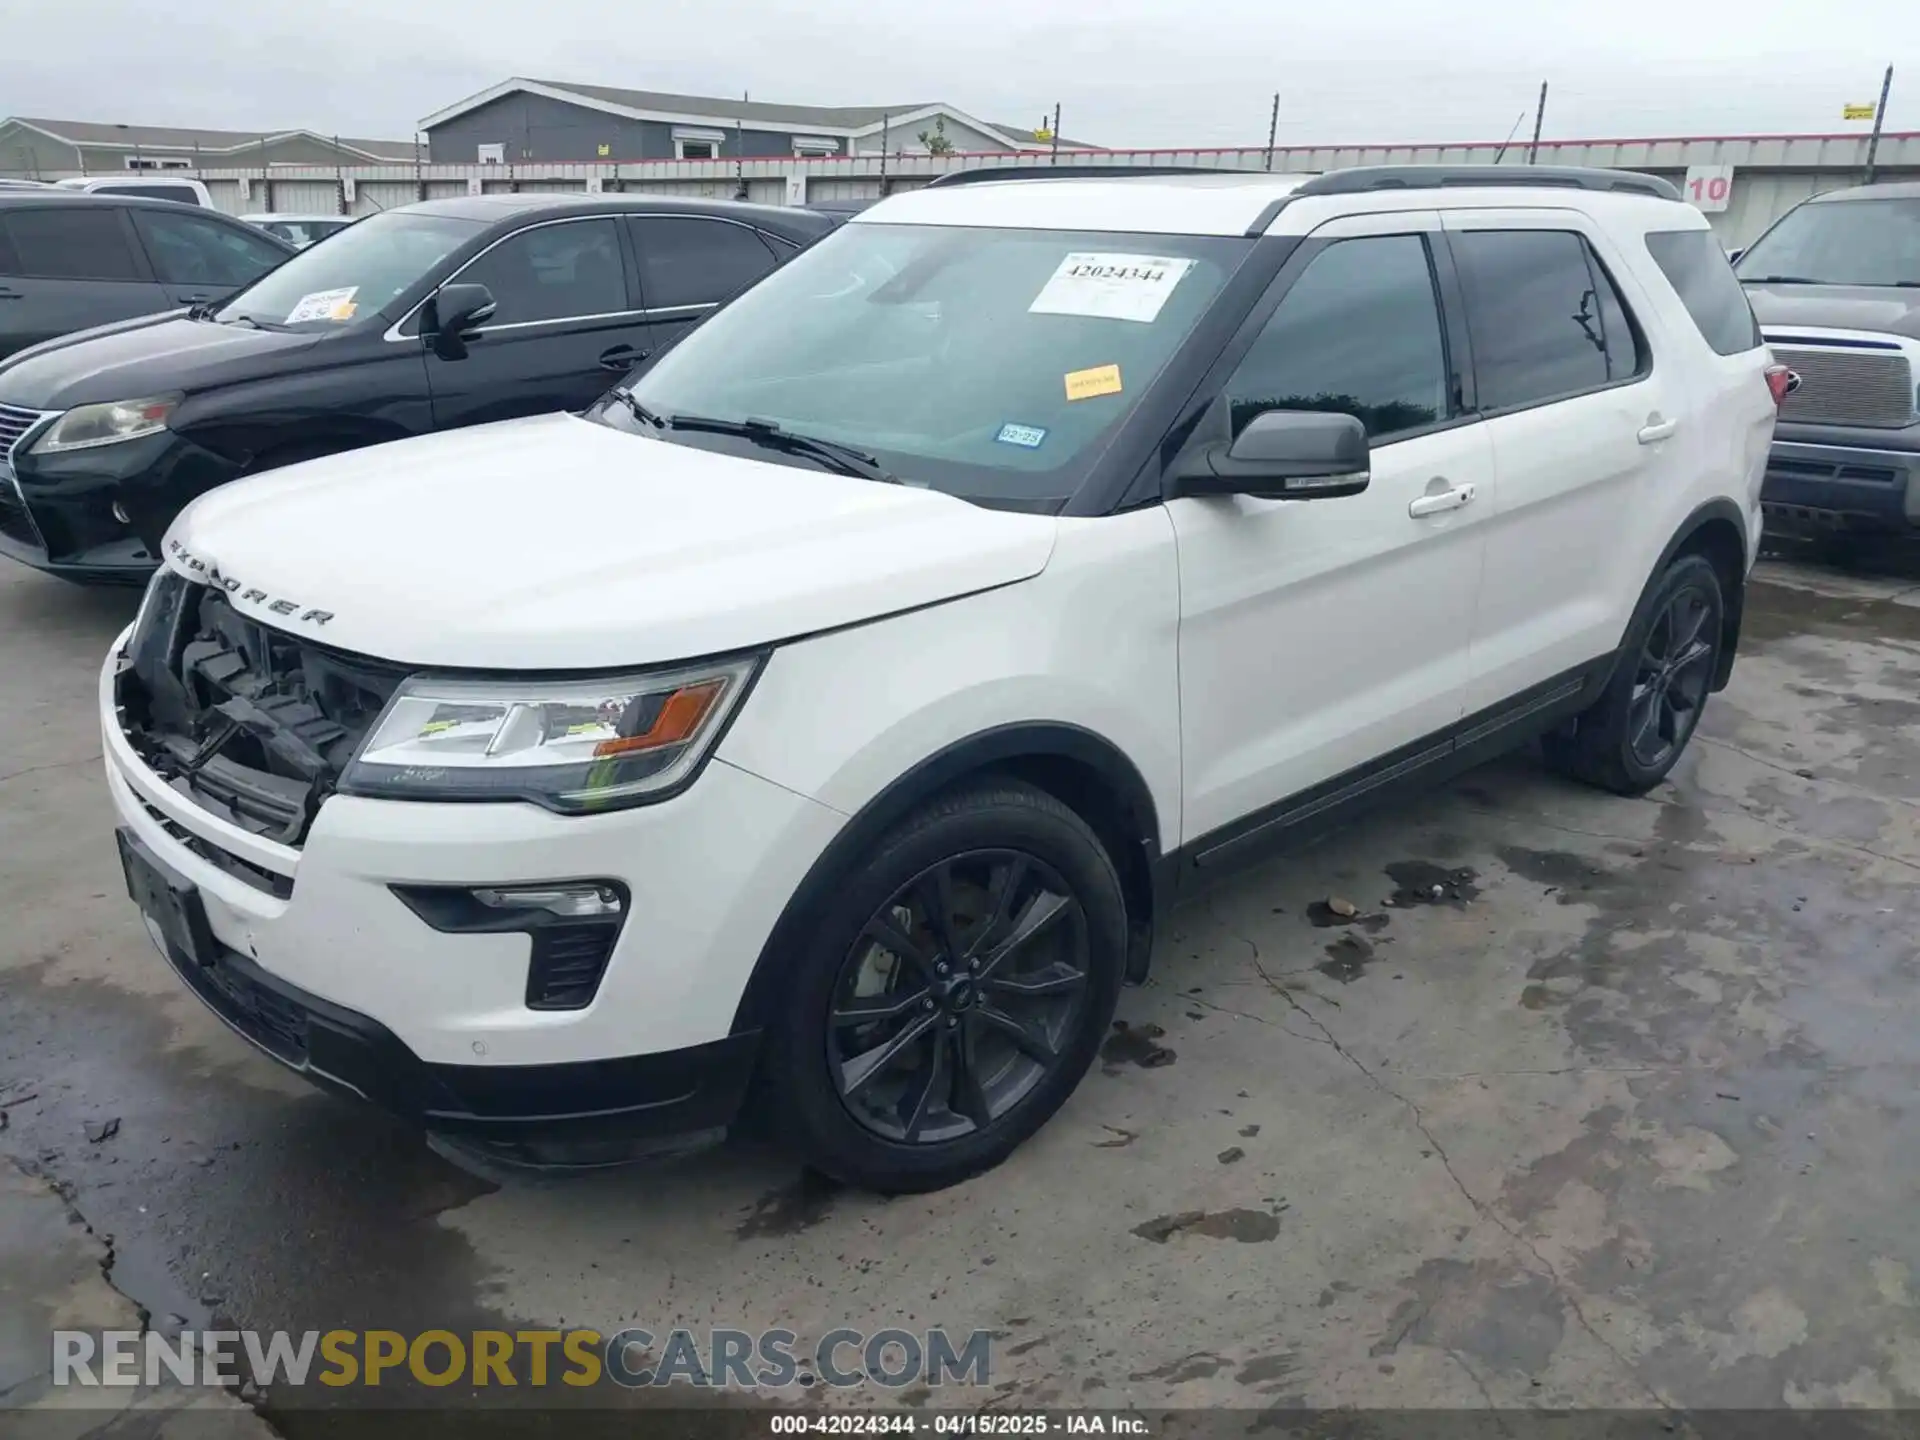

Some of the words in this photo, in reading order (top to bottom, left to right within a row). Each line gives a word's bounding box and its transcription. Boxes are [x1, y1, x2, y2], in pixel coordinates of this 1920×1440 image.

[792, 182, 800, 199] 7
[1689, 177, 1728, 201] 10
[1067, 264, 1165, 281] 42024344
